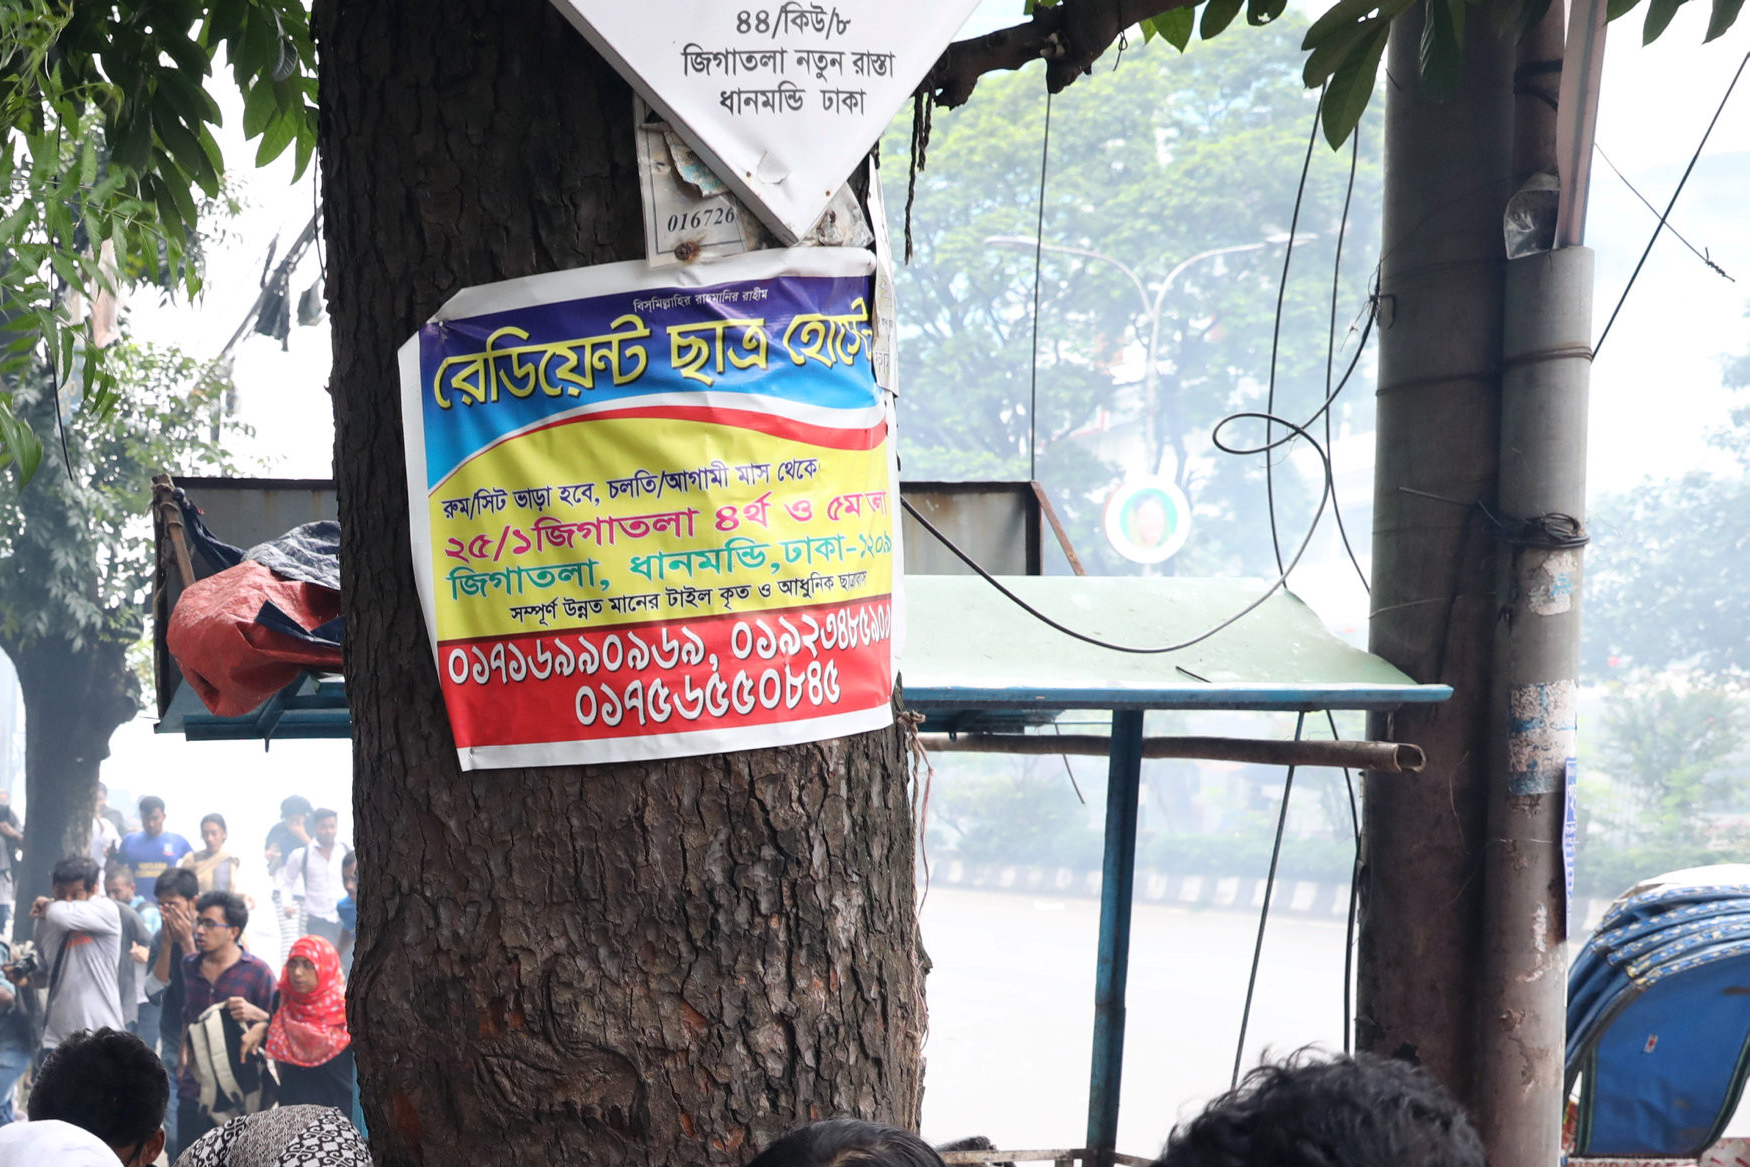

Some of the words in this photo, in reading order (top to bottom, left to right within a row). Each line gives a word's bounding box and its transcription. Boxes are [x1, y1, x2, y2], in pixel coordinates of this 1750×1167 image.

[736, 1, 851, 40] ৪৪/কিউ/৮
[680, 43, 788, 77] জিগাতলা
[794, 49, 846, 83] নতুন
[851, 49, 896, 78] রাস্তা
[719, 80, 806, 116] ধানমন্ডি
[820, 87, 867, 115] ঢাকা
[434, 313, 650, 410] রেডিয়েন্ট
[666, 317, 768, 387] ছাত্র
[513, 485, 552, 512] ভাড়া
[558, 482, 601, 507] হবে,
[606, 459, 730, 499] চলতি/আগামী
[735, 462, 771, 486] মাস
[777, 457, 817, 482] থেকে
[715, 491, 772, 532] ৪র্থ
[784, 499, 812, 523] ও
[826, 493, 864, 521] ৫ম
[445, 557, 611, 601] জিগাতলা,
[509, 596, 559, 626] সম্পূর্ণ
[563, 596, 603, 621] উন্নত
[607, 593, 661, 614] মানের
[665, 585, 714, 608] টাইল
[719, 584, 752, 610] কৃত
[758, 583, 772, 598] ও
[777, 571, 835, 599] আধুনিক
[575, 658, 842, 727] ০১৭৫৬৫৫০৮৪৫
